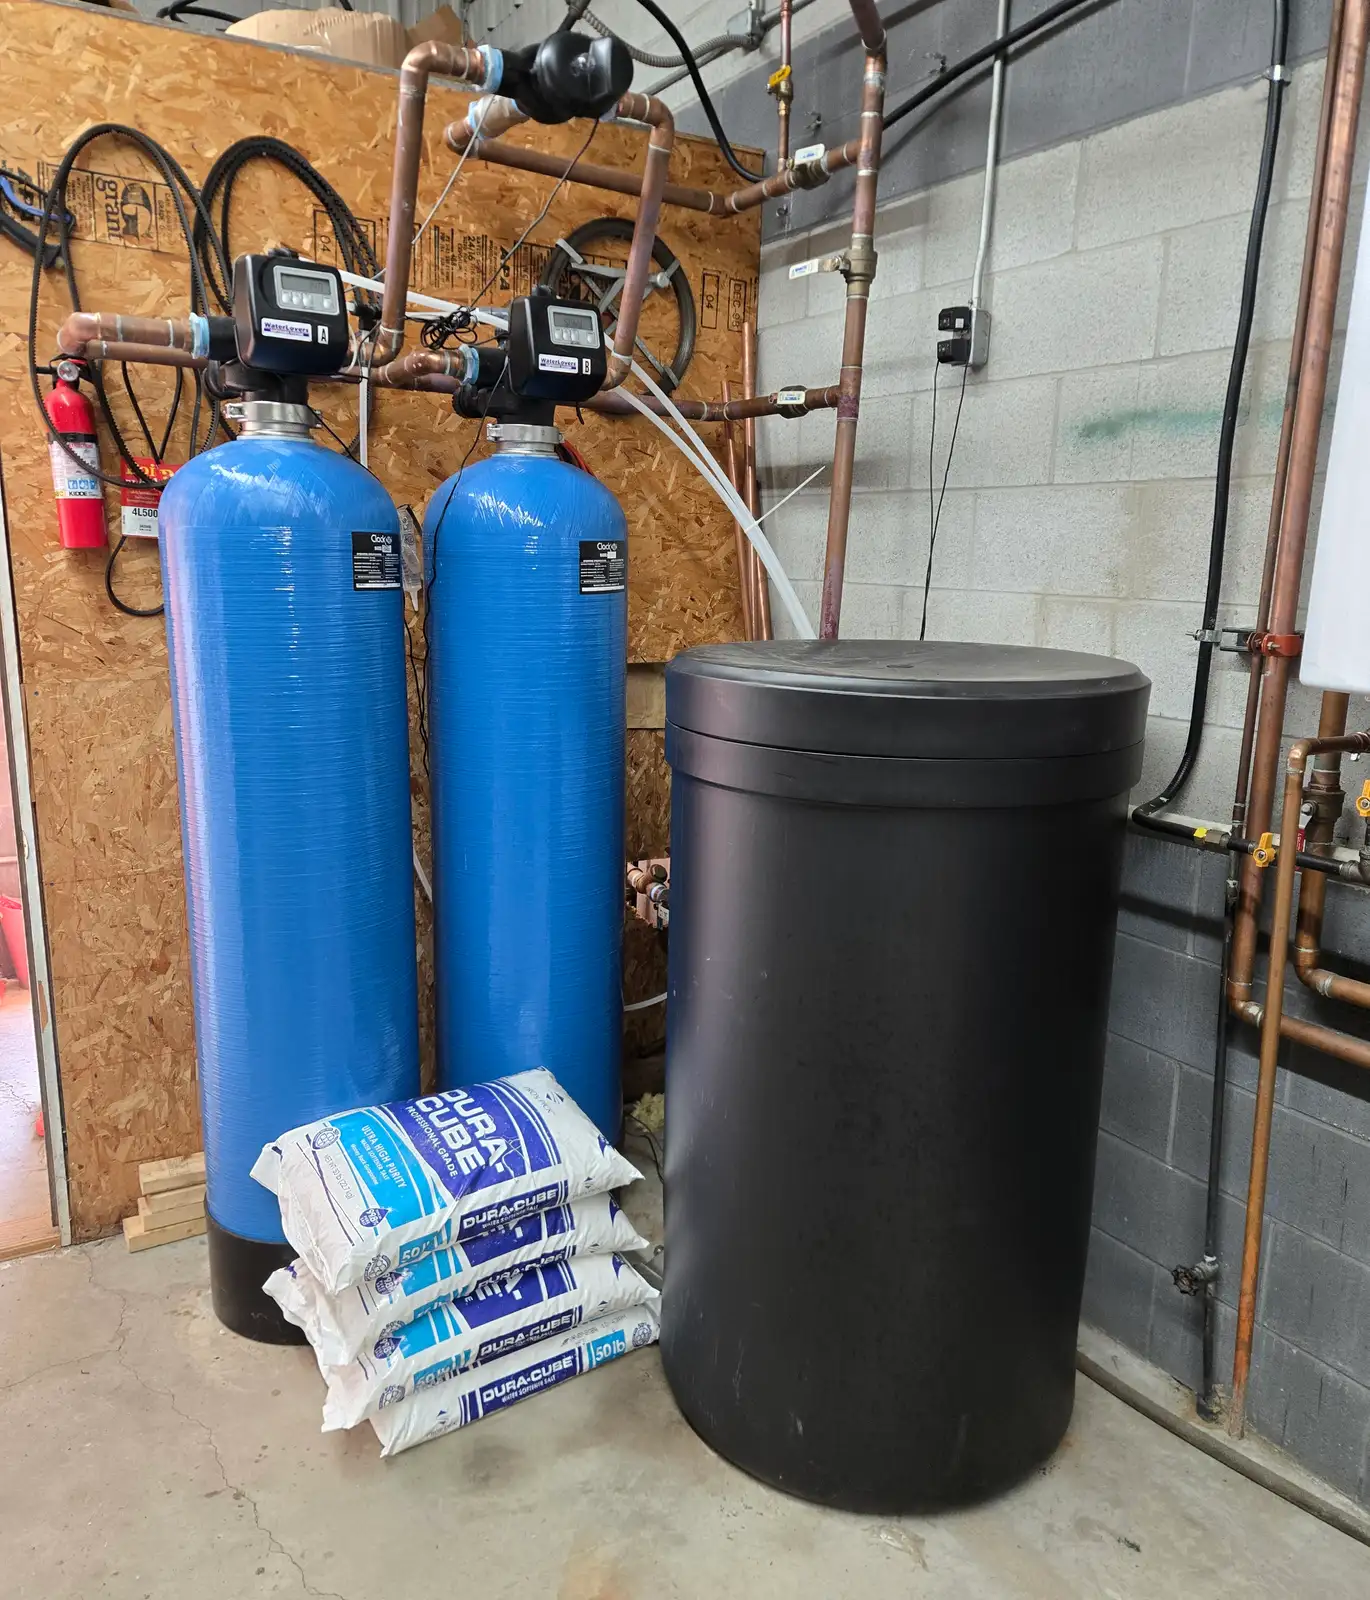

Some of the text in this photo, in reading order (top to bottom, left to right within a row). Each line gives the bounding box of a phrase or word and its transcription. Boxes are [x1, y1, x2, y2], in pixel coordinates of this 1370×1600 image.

[97, 176, 122, 241] grant
[467, 235, 476, 261] 24/16
[705, 294, 715, 310] 04
[264, 321, 309, 333] WaterLovers
[320, 328, 326, 342] A
[540, 357, 576, 367] WaterLovers
[584, 360, 590, 373] B
[132, 507, 158, 518] 4L500
[405, 1105, 458, 1178] PROFESSIONAL GRADE
[415, 1096, 485, 1176] CUBE
[361, 1125, 407, 1188] ULTRA HIGH PURITY
[402, 1246, 420, 1260] 50
[595, 1339, 626, 1361] 50 lb
[482, 1355, 575, 1403] DURA-CUBE
[501, 1374, 557, 1403] WATER SOFTENER SALT
